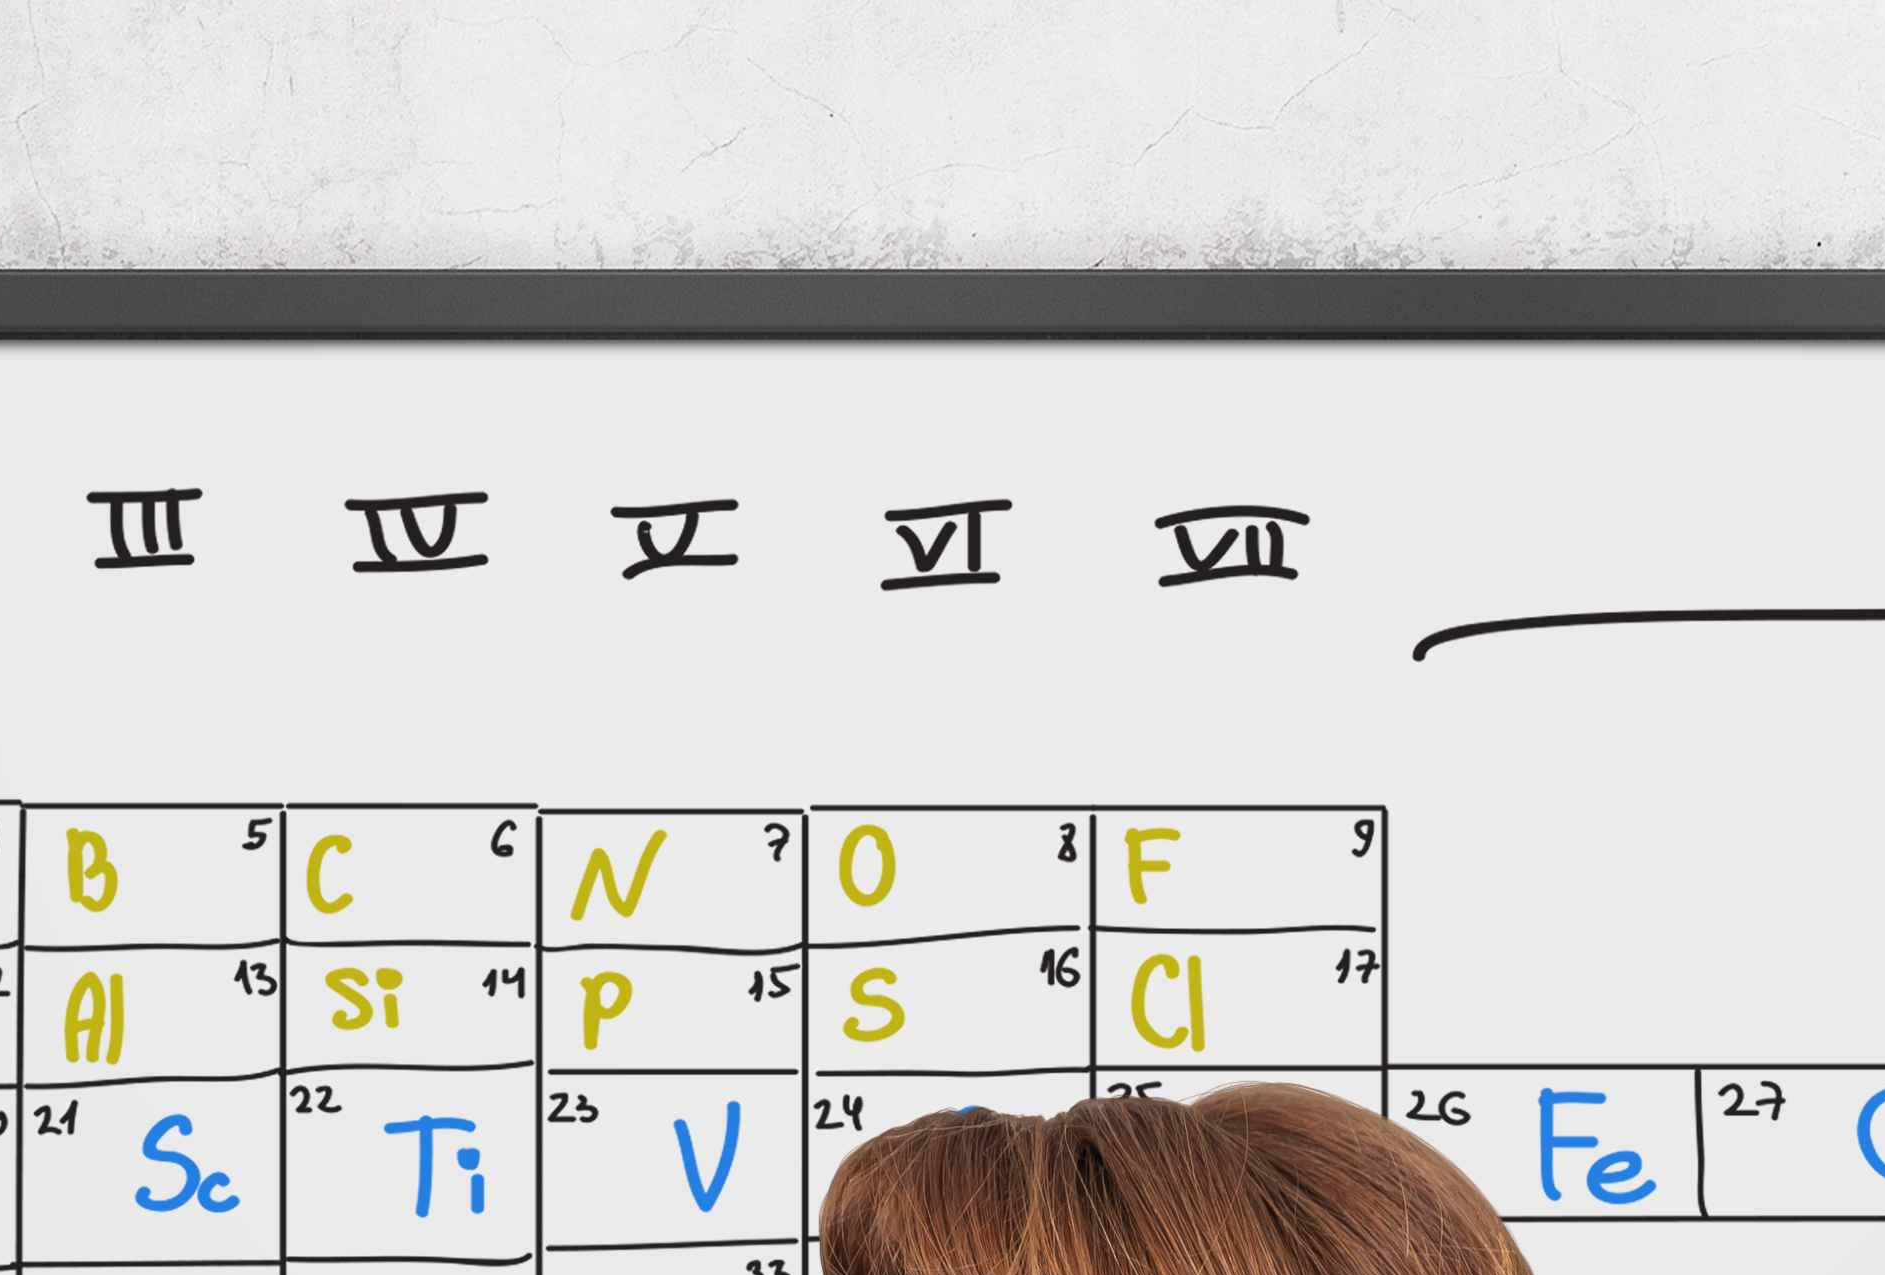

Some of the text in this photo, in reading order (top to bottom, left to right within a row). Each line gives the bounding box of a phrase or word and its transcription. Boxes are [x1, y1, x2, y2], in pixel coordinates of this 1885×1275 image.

[86, 488, 203, 569] III
[344, 492, 489, 573] IV
[610, 499, 739, 580] V
[880, 499, 1013, 591] VI
[1154, 505, 1310, 588] VII
[65, 817, 273, 913] B 5
[306, 819, 517, 915] C 6
[570, 822, 790, 922] N 7
[838, 822, 1077, 907] O 8
[1124, 819, 1375, 905] F 9
[64, 959, 278, 1065] Al 13
[324, 966, 525, 1031] Si 14
[579, 962, 803, 1051] P 15
[842, 946, 1081, 1043] S 16
[1130, 948, 1380, 1052] Cl 17
[1406, 1087, 1657, 1205] 26 Fe
[1718, 1080, 1786, 1121] 27
[33, 1099, 241, 1214] 21 Sc
[289, 1085, 486, 1218] 22 Ti
[547, 1092, 741, 1213] 23 V
